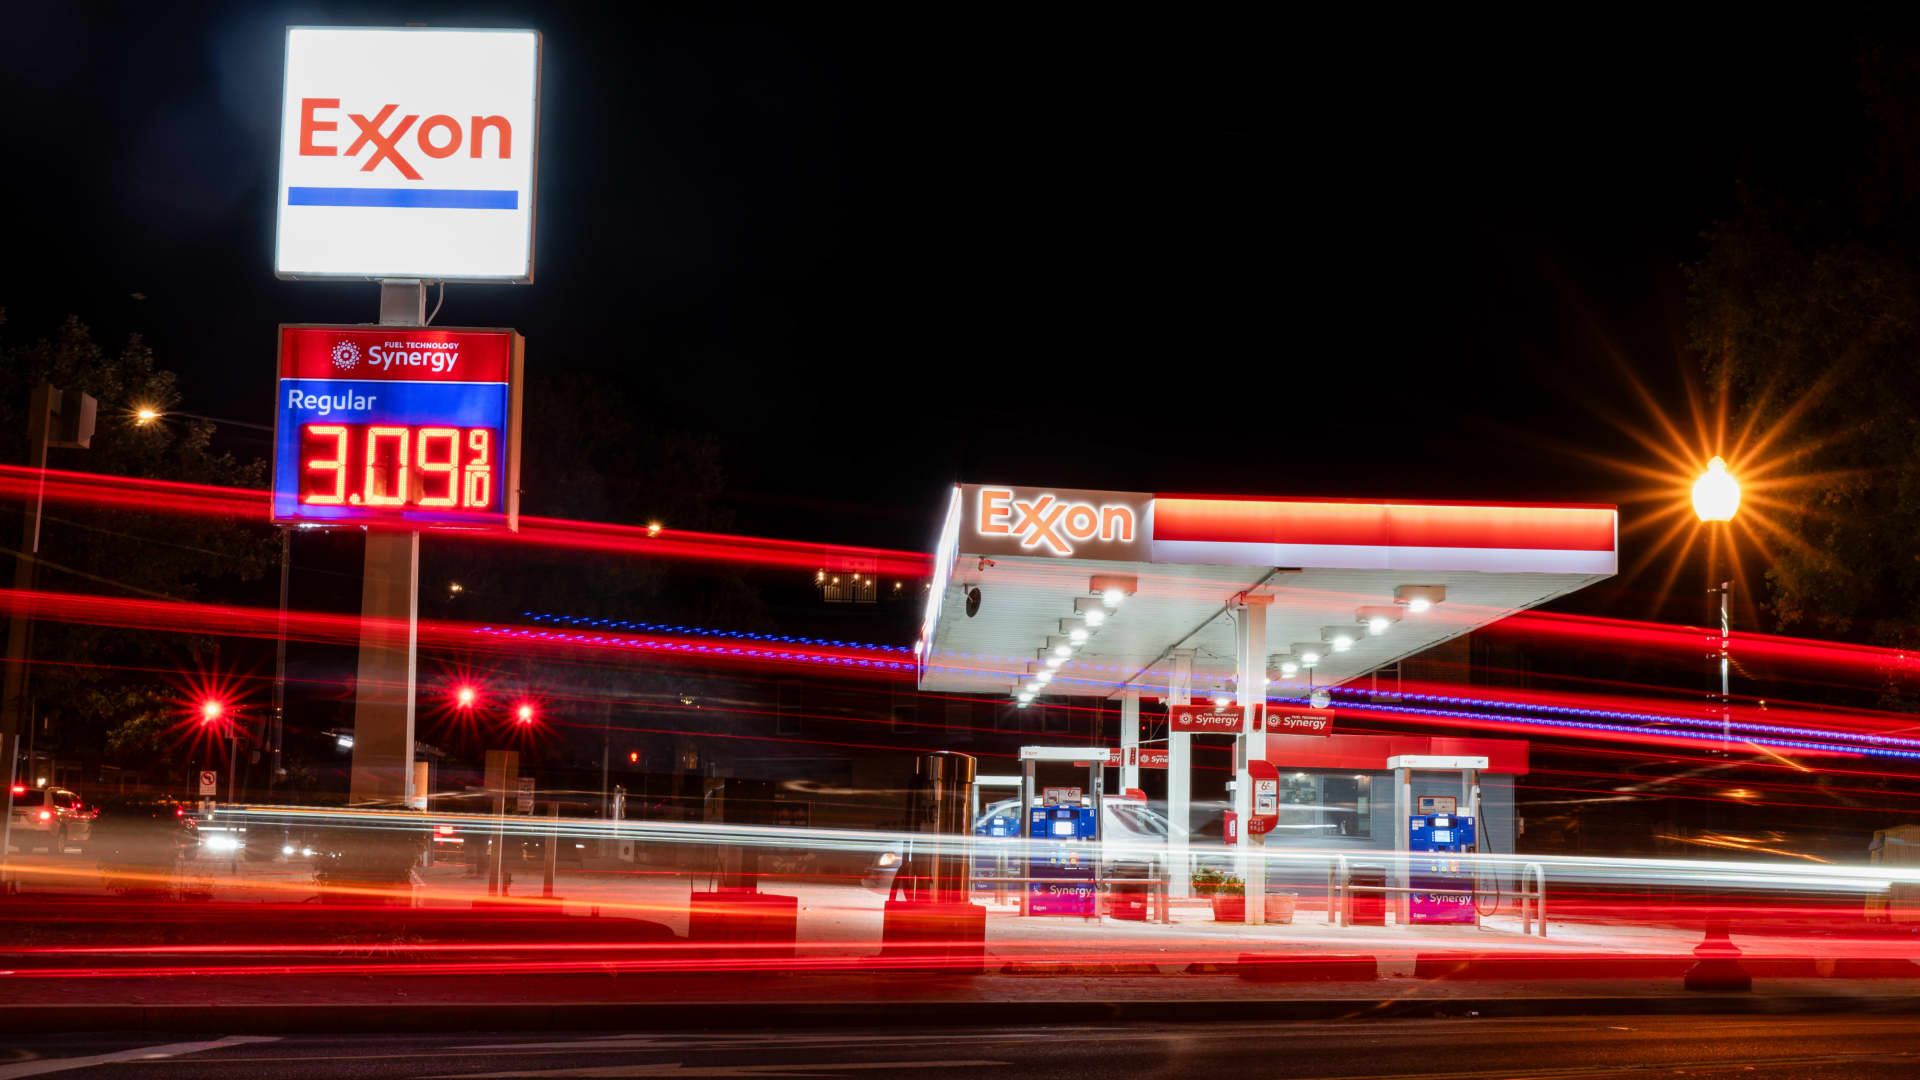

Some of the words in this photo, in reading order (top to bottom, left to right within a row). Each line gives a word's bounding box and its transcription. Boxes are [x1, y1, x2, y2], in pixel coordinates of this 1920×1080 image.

[299, 98, 513, 181] Exxon
[384, 341, 404, 349] FUEL
[406, 342, 459, 350] TECHNOLOGY
[368, 346, 459, 372] Synergy
[288, 389, 377, 415] Regular
[304, 425, 460, 507] 3.09
[980, 490, 1133, 553] Exxon
[1196, 714, 1239, 726] Synergy
[1283, 716, 1326, 730] Synergy
[1049, 885, 1092, 897] Synergy
[1430, 893, 1472, 906] Synergy
